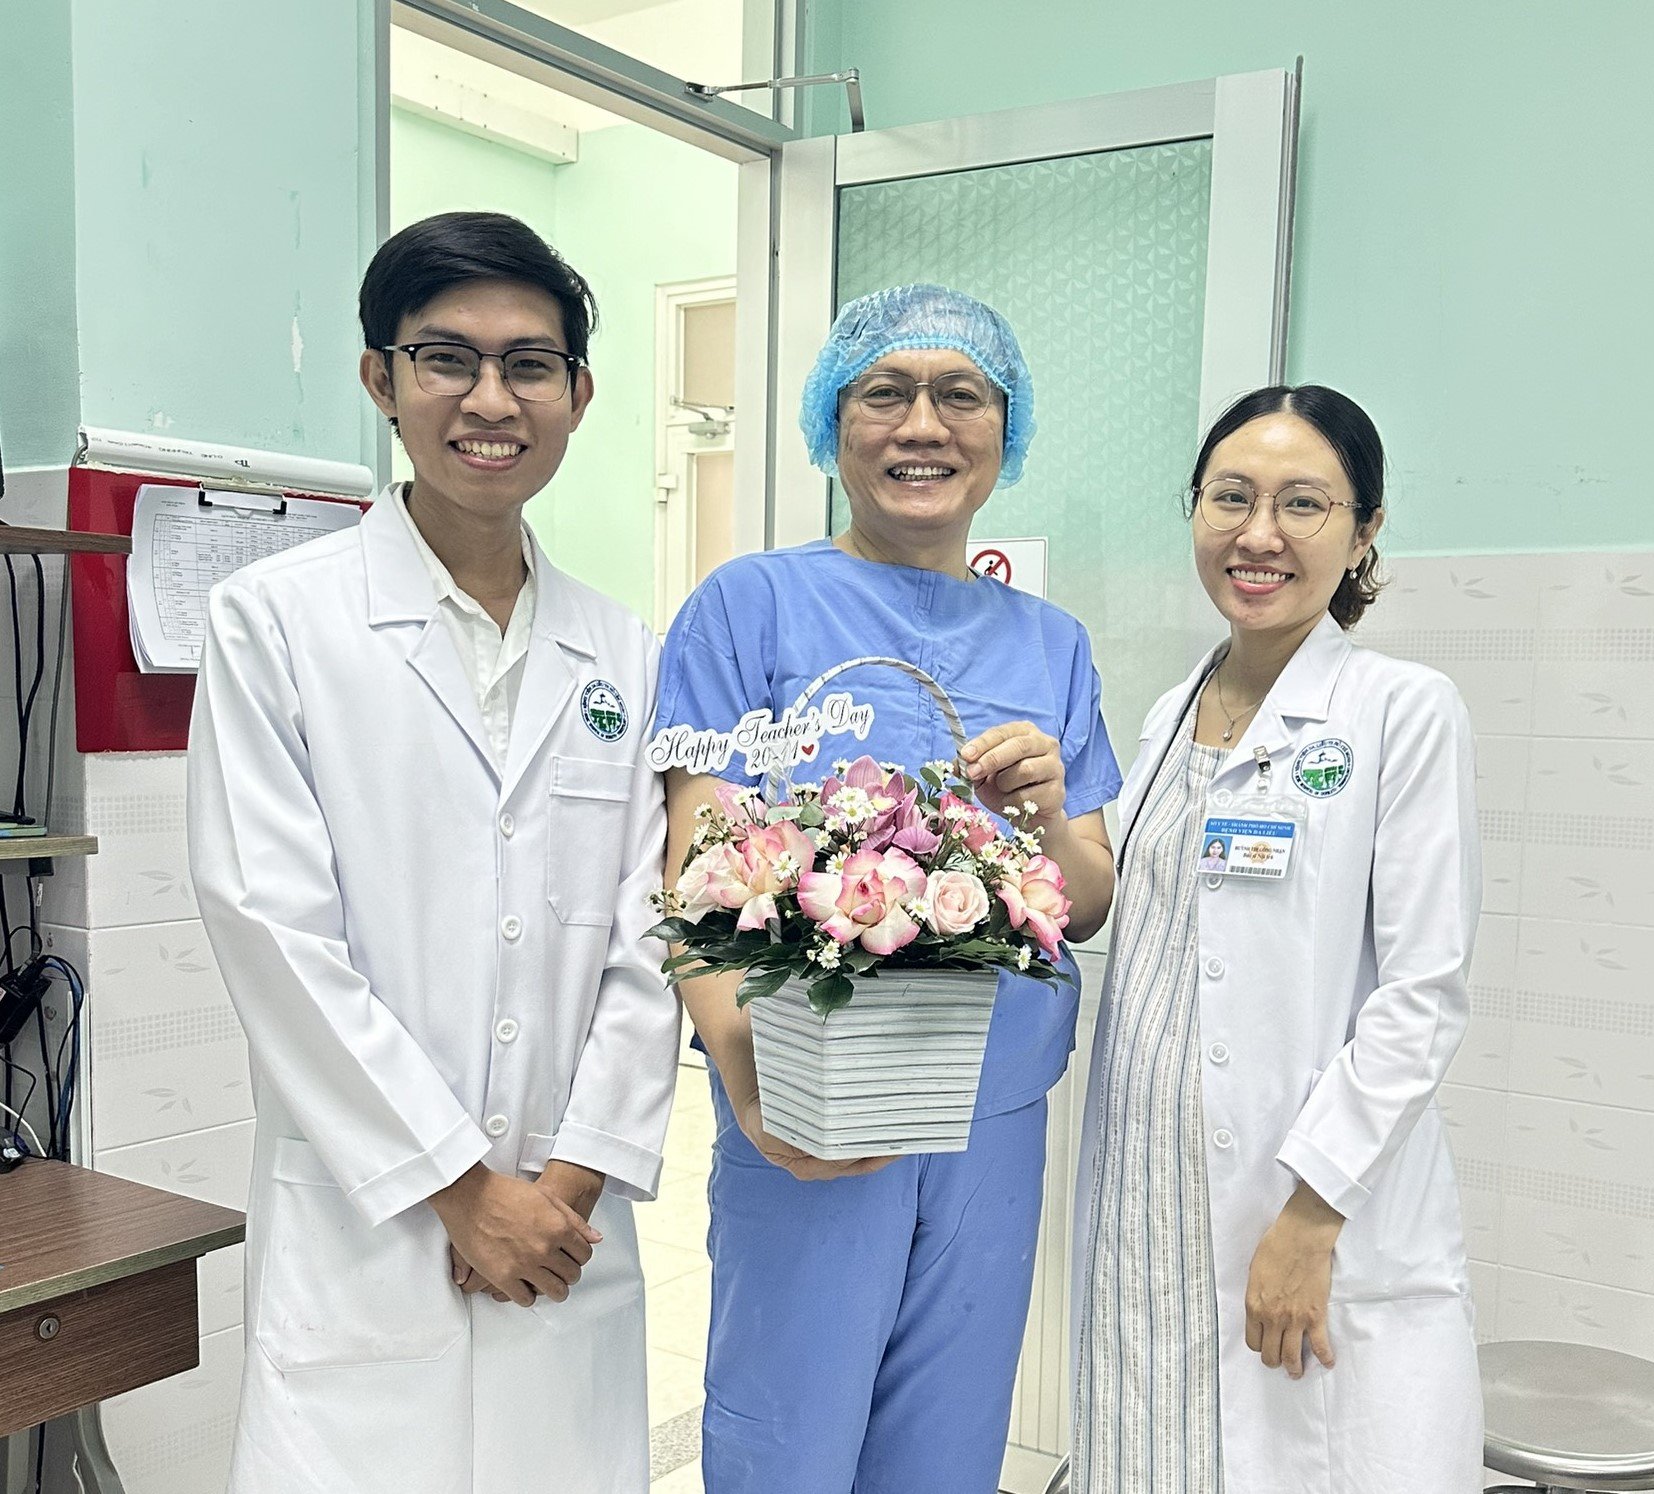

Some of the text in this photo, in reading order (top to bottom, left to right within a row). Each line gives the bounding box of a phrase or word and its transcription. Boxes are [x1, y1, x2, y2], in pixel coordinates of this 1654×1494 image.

[650, 698, 870, 768] Happy Teacher's Day
